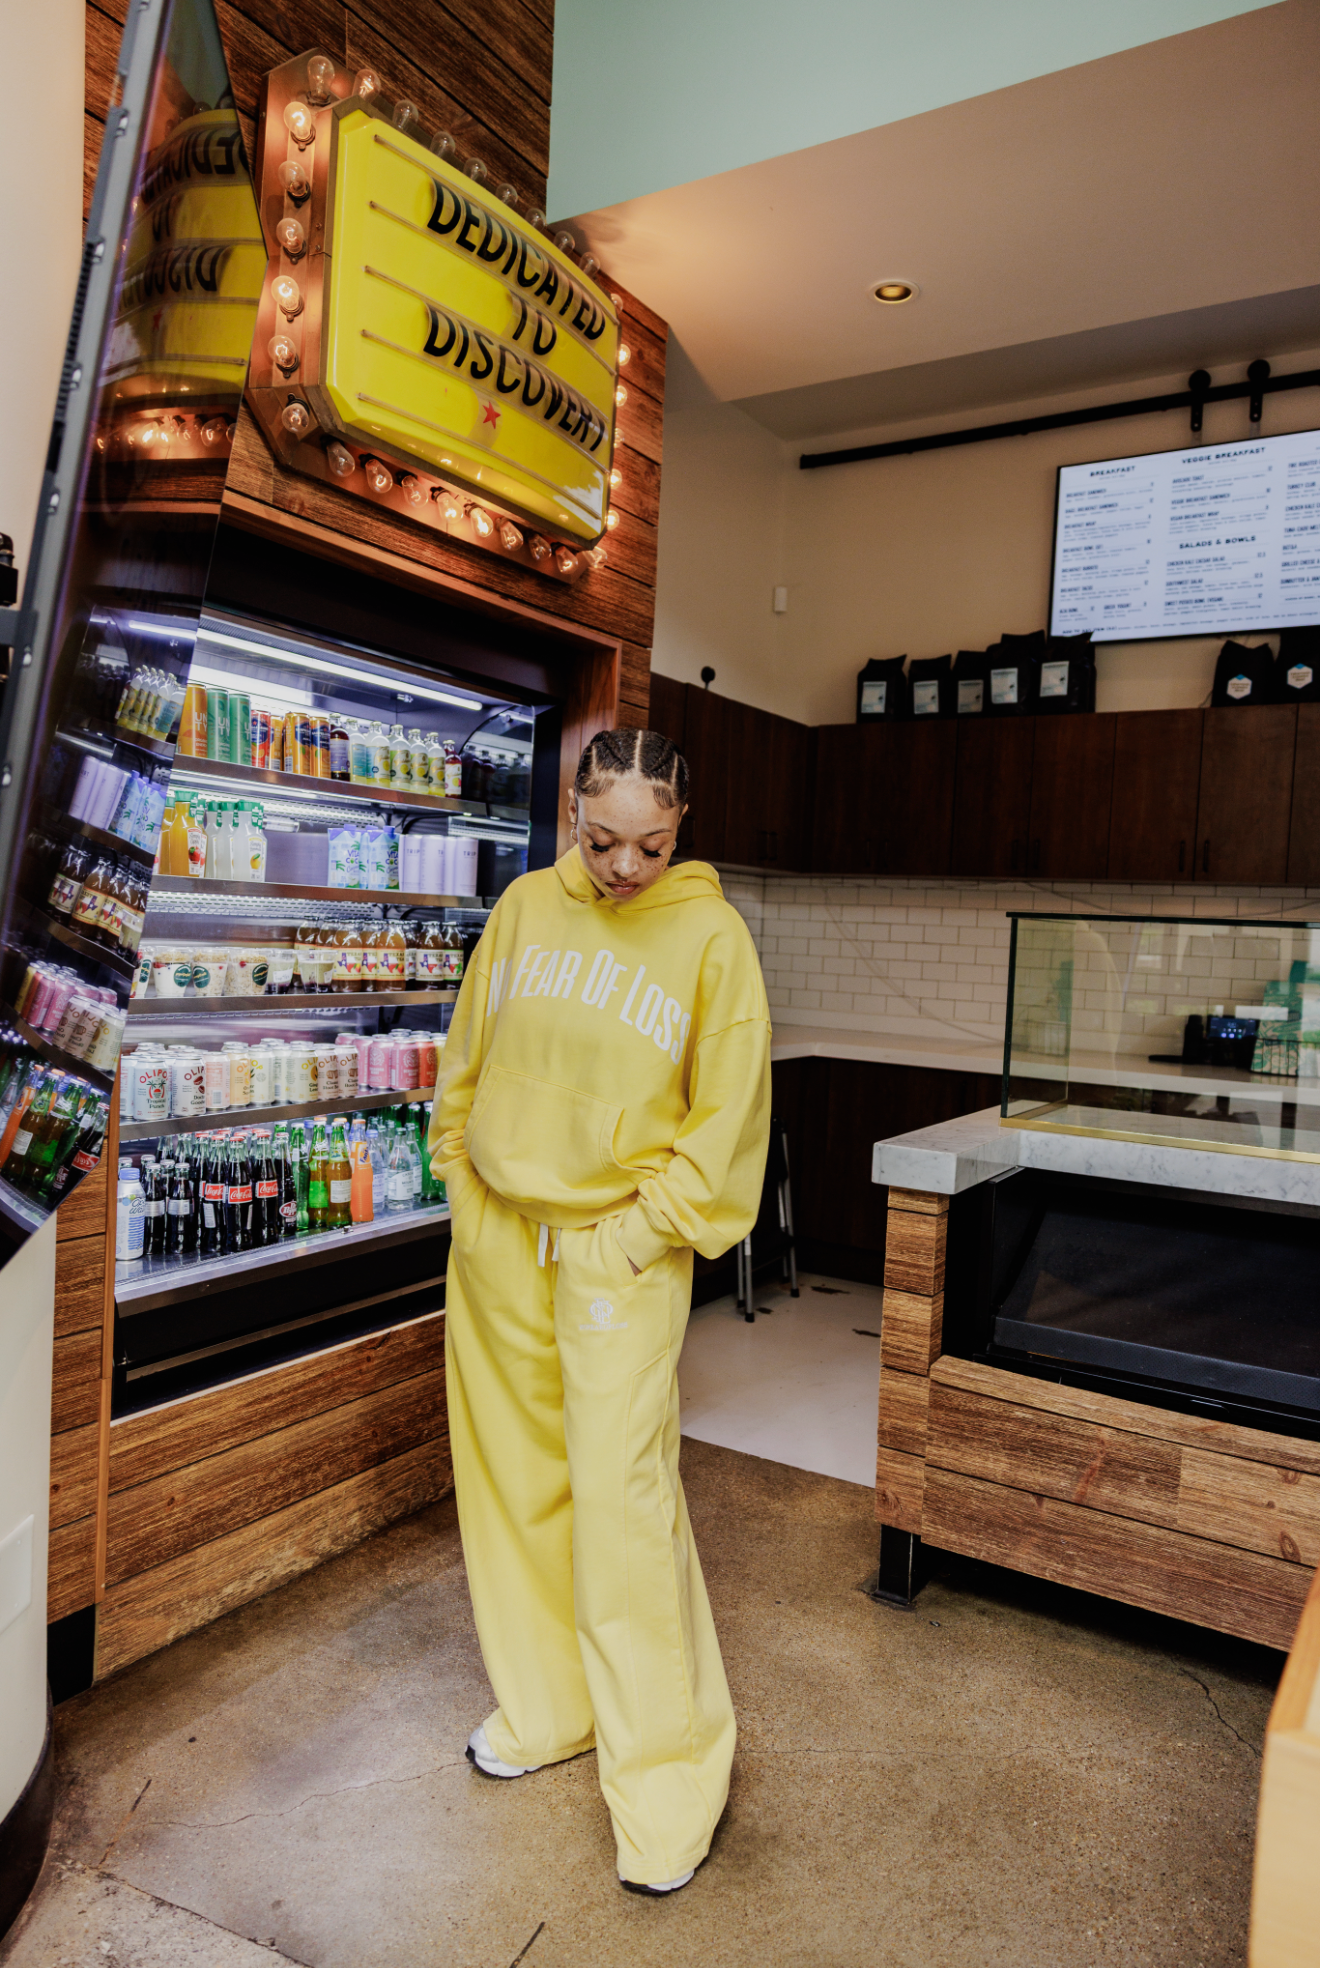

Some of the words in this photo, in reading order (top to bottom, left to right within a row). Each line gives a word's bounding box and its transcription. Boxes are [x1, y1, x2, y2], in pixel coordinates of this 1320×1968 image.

[427, 177, 606, 341] DEDICATED
[509, 290, 557, 356] TO
[423, 308, 606, 452] DISCOVERY
[1090, 465, 1136, 477] BREAKFAST
[1182, 454, 1211, 464] VEGGIE
[1215, 447, 1266, 459] BREAKFAST
[1179, 540, 1212, 549] SALADS
[1226, 536, 1256, 544] BOWLS
[508, 944, 583, 1000] FEAR
[581, 949, 628, 1010] OF
[619, 964, 692, 1066] LOSS
